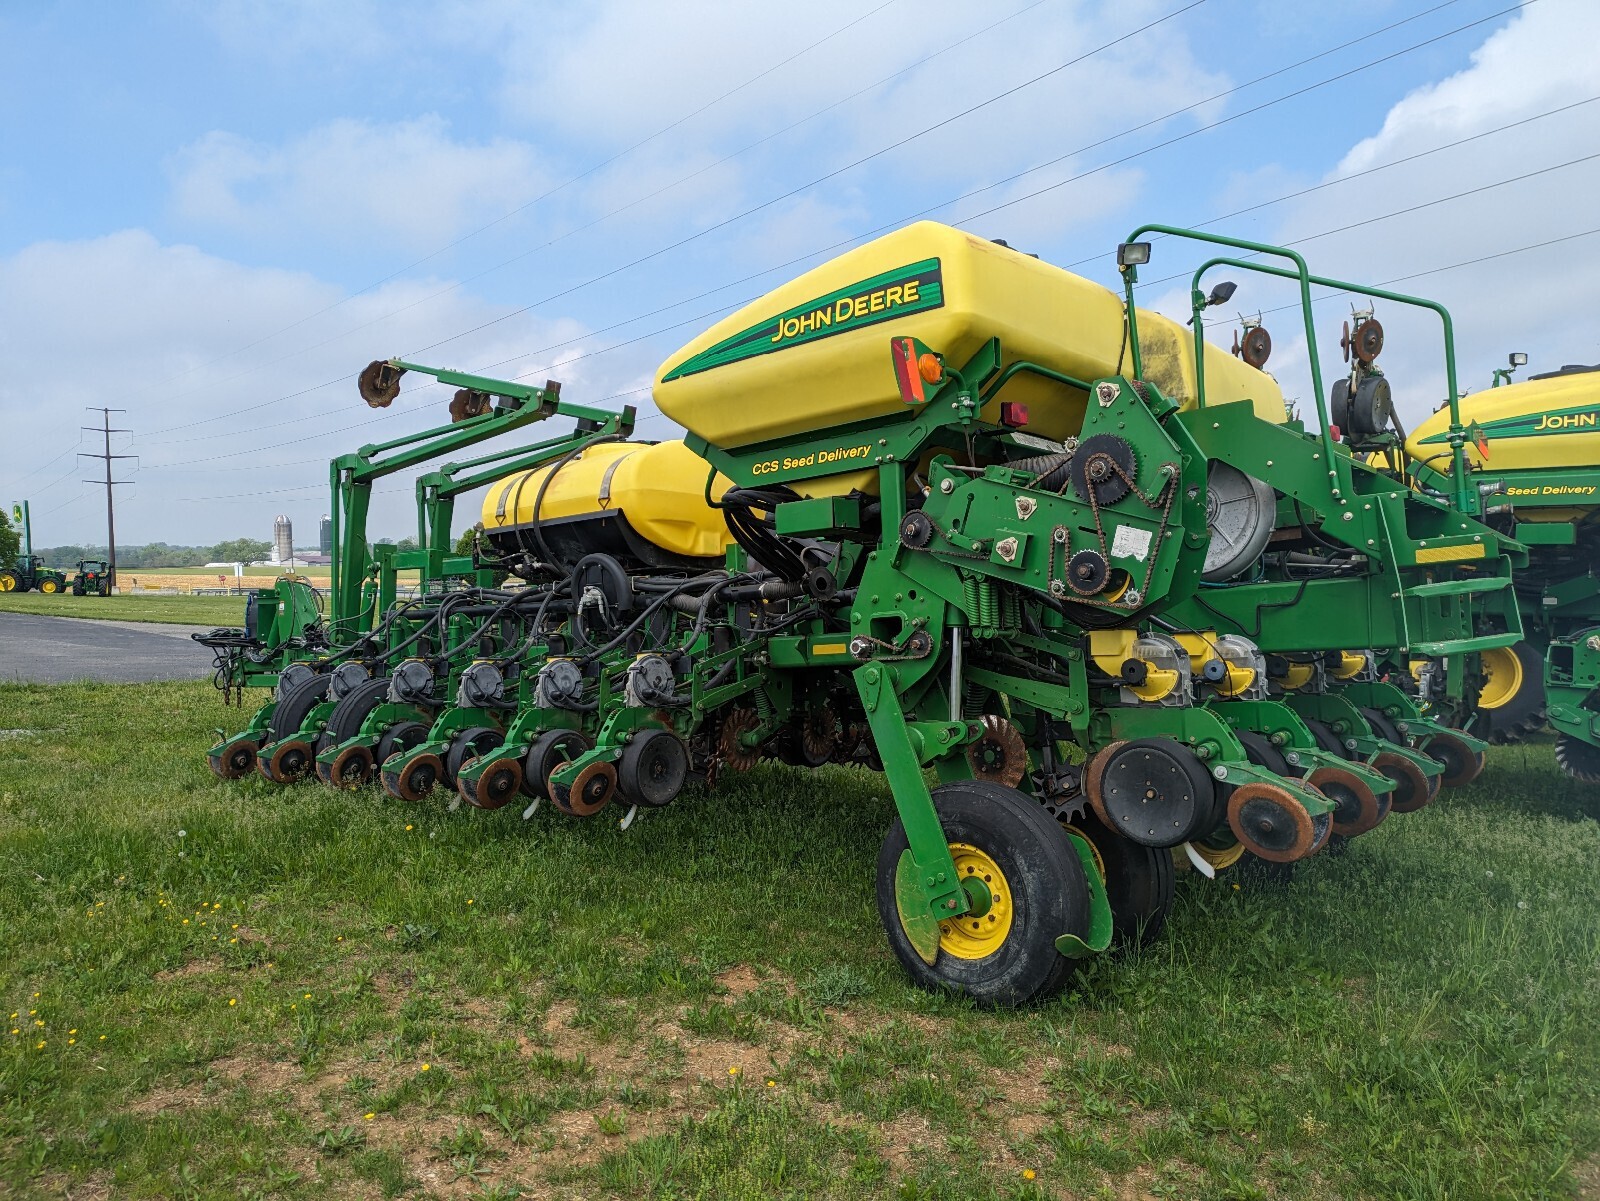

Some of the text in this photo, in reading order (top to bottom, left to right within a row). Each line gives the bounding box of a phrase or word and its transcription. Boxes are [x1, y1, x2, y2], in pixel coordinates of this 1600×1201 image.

[771, 280, 920, 343] JOHN DEERE
[1535, 413, 1596, 430] JOHN
[752, 444, 872, 475] CCS Seed Delivery
[1507, 487, 1539, 495] Seed
[1542, 486, 1596, 495] Delivery
